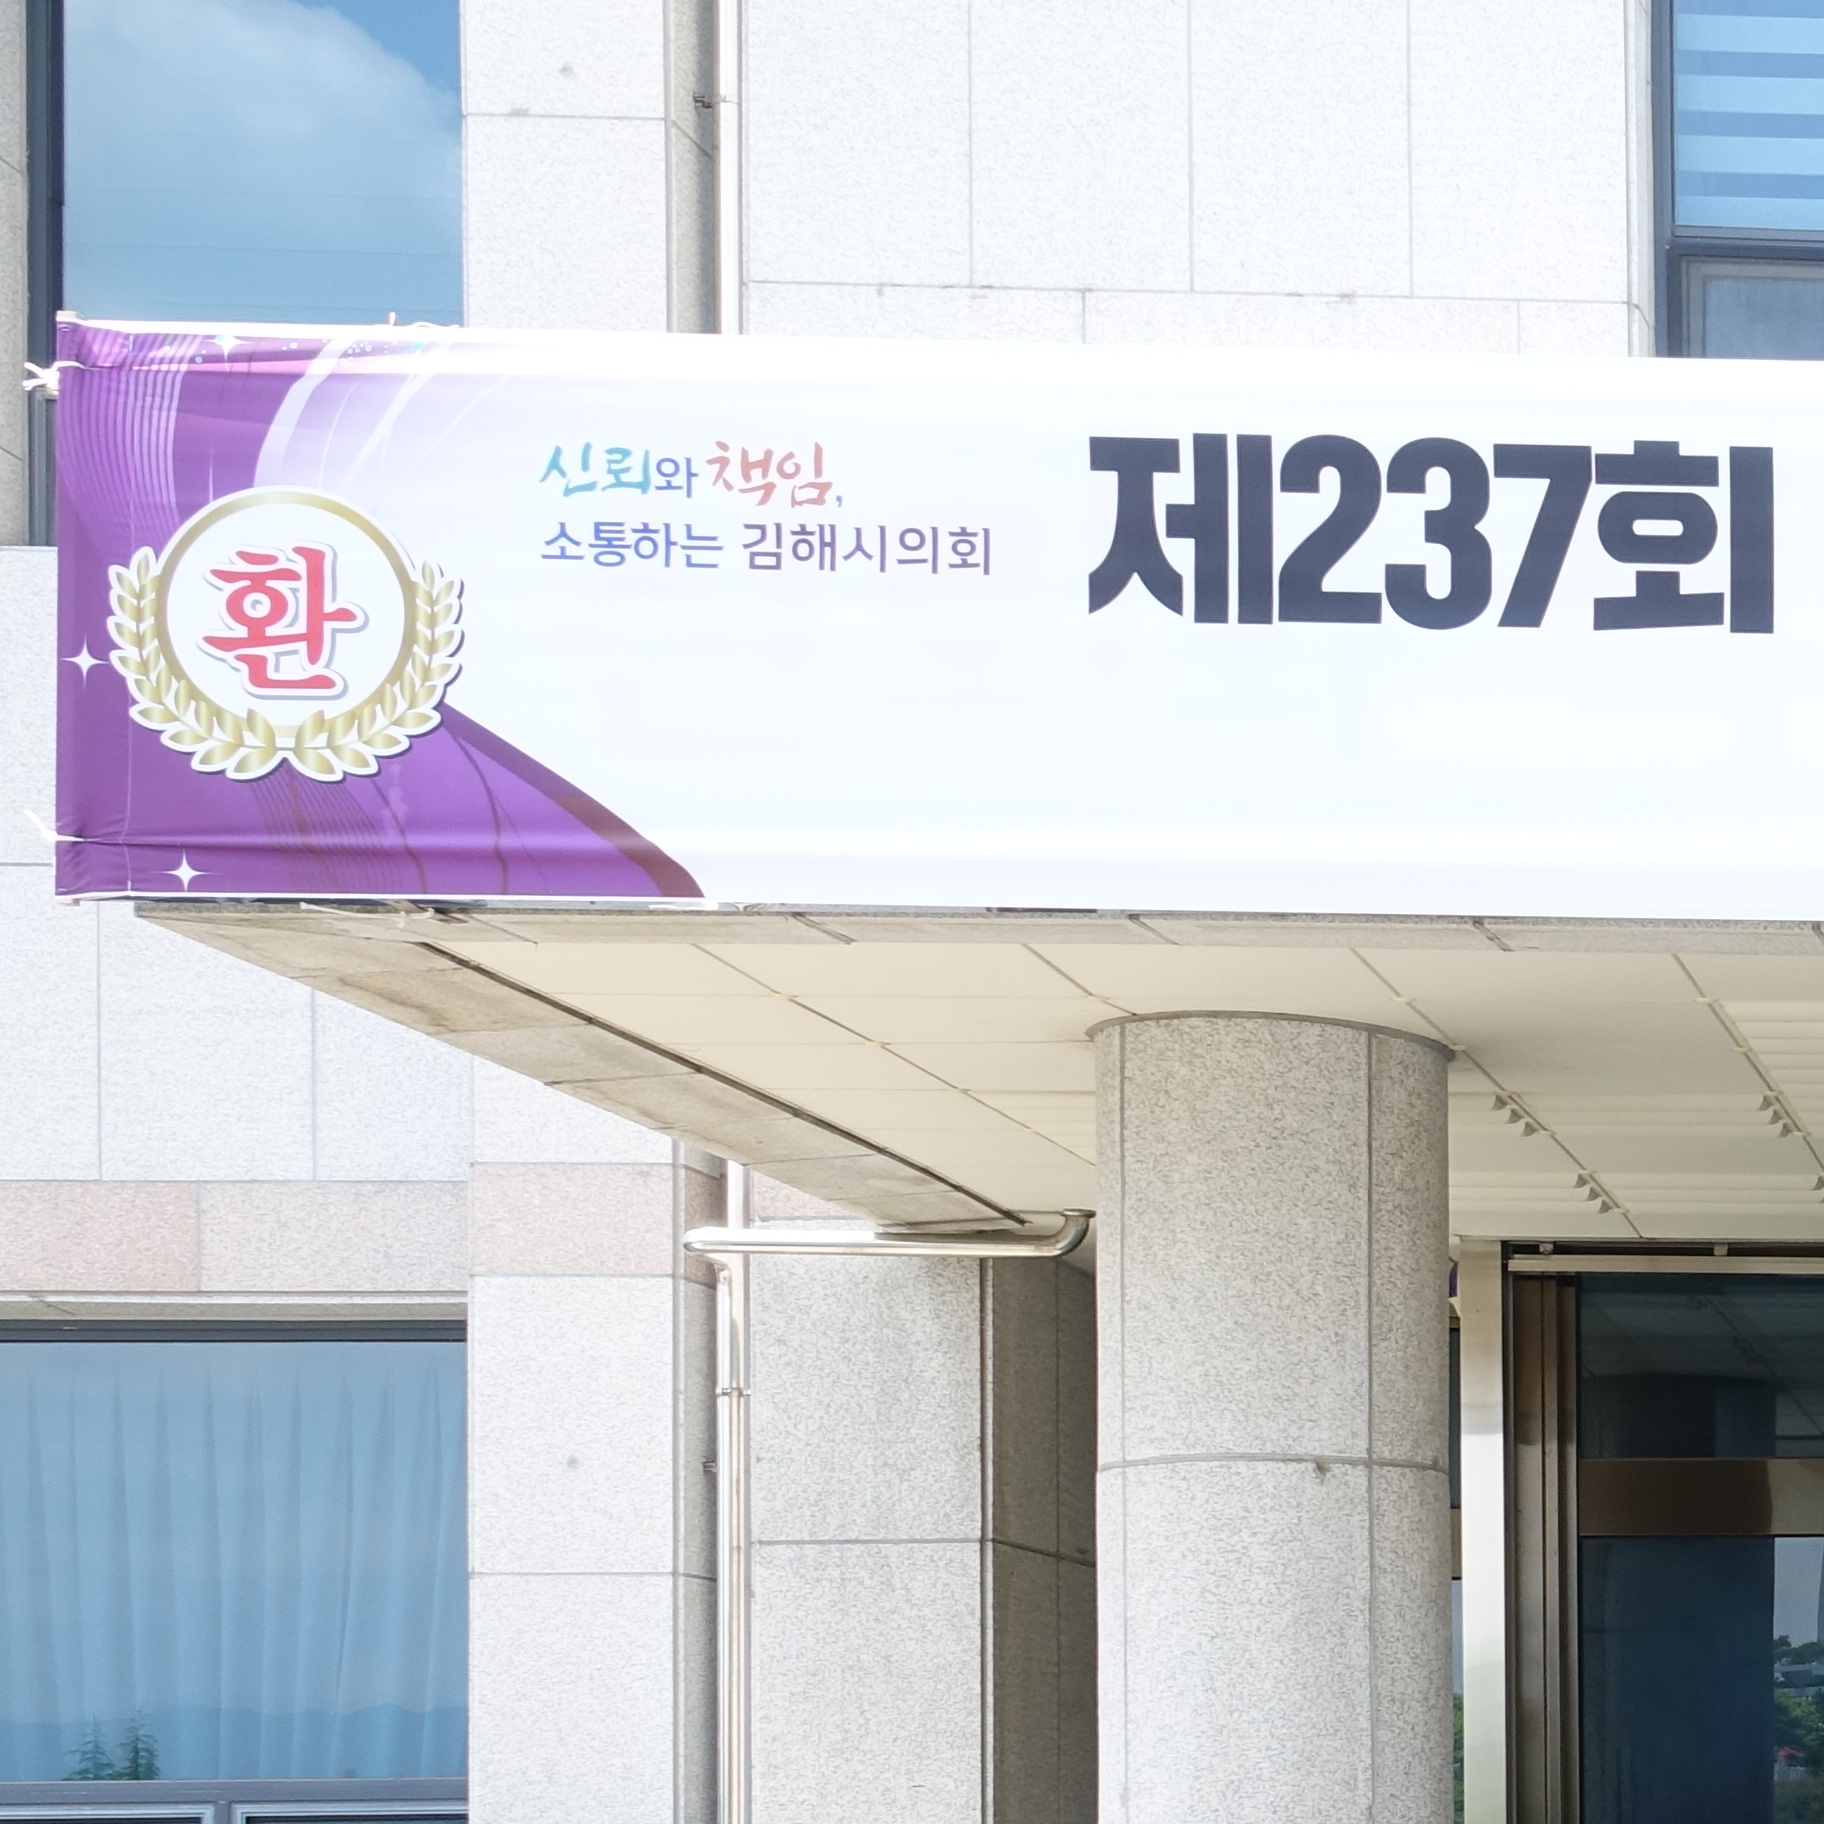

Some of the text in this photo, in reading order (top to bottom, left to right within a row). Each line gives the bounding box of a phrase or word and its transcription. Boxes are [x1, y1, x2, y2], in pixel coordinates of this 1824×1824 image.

[539, 441, 843, 508] 신뢰와 책임,
[541, 522, 991, 576] 소통하는 김해시의회
[1089, 433, 1775, 634] 제237회
[202, 546, 358, 690] 환
